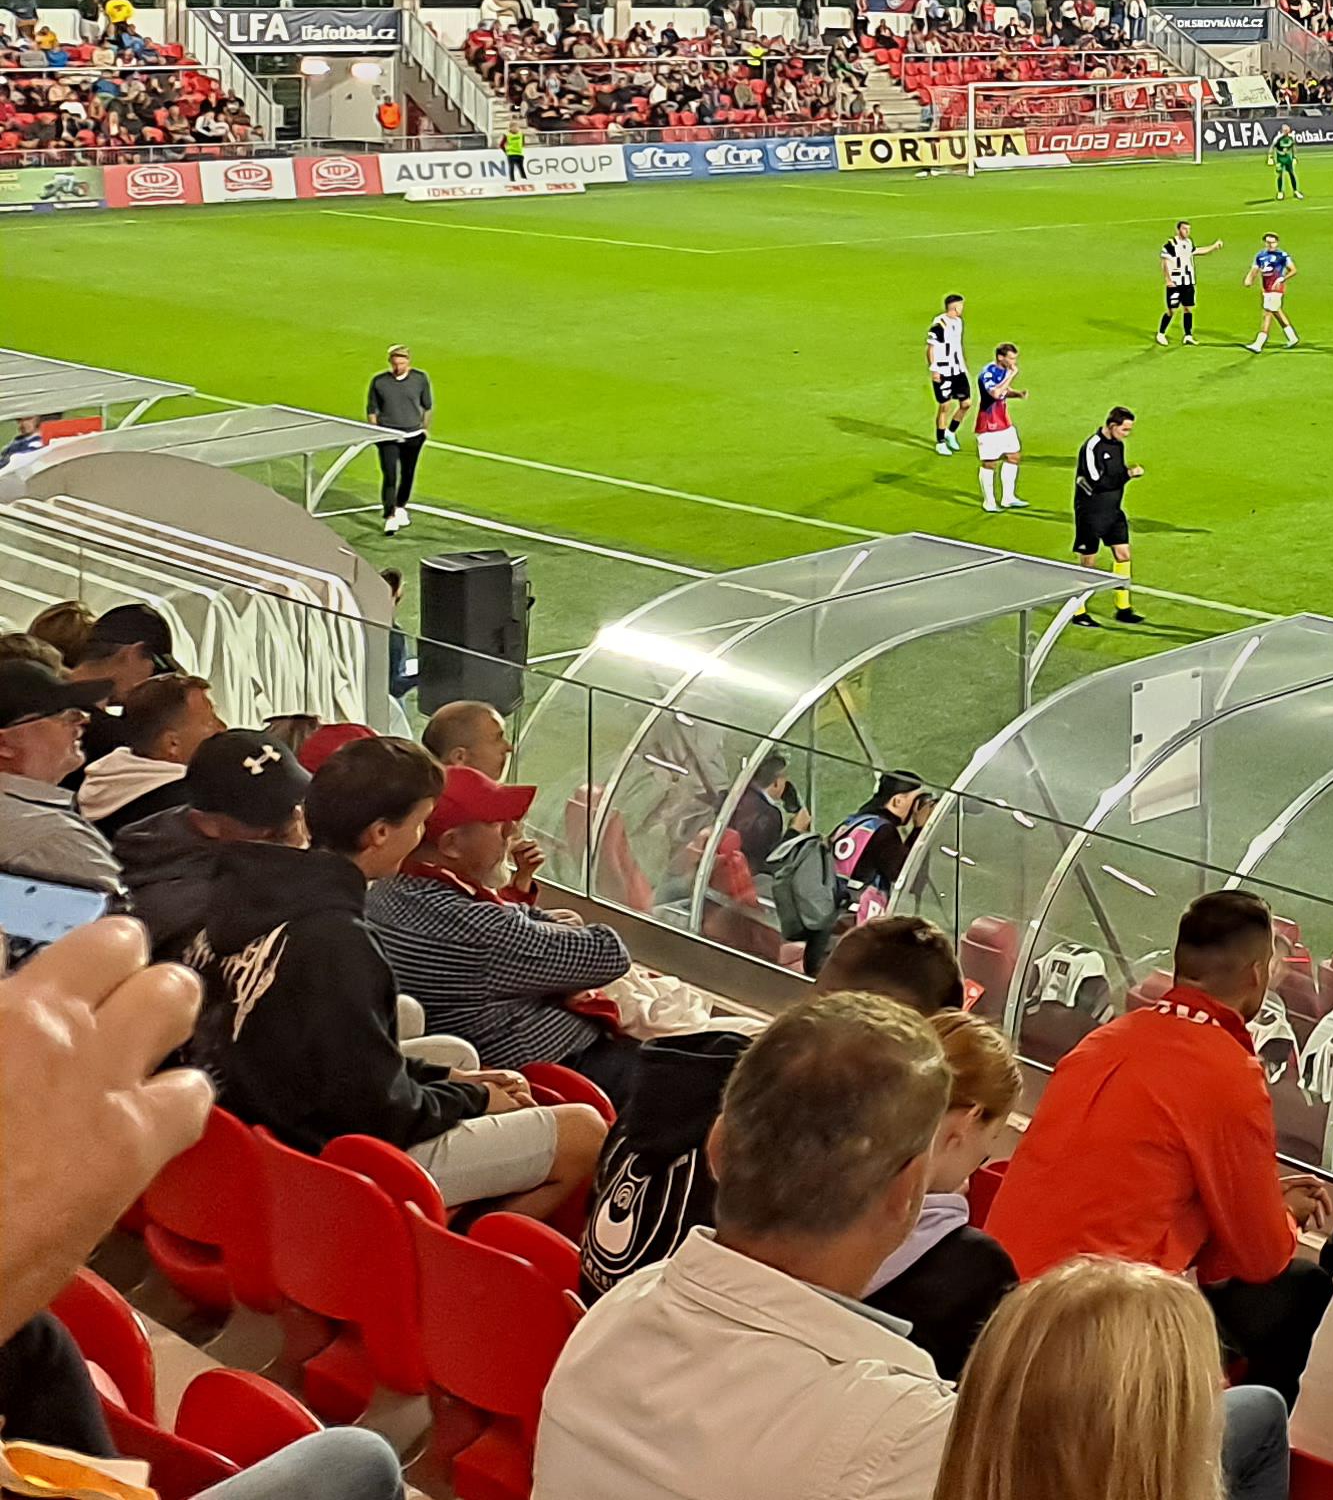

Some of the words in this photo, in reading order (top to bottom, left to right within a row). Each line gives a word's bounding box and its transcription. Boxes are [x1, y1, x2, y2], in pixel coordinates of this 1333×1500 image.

[229, 13, 289, 42] LFA
[1228, 122, 1268, 147] LFA
[844, 134, 1021, 165] FORTUNA
[397, 161, 473, 181] AUTO
[527, 155, 613, 175] GROUP
